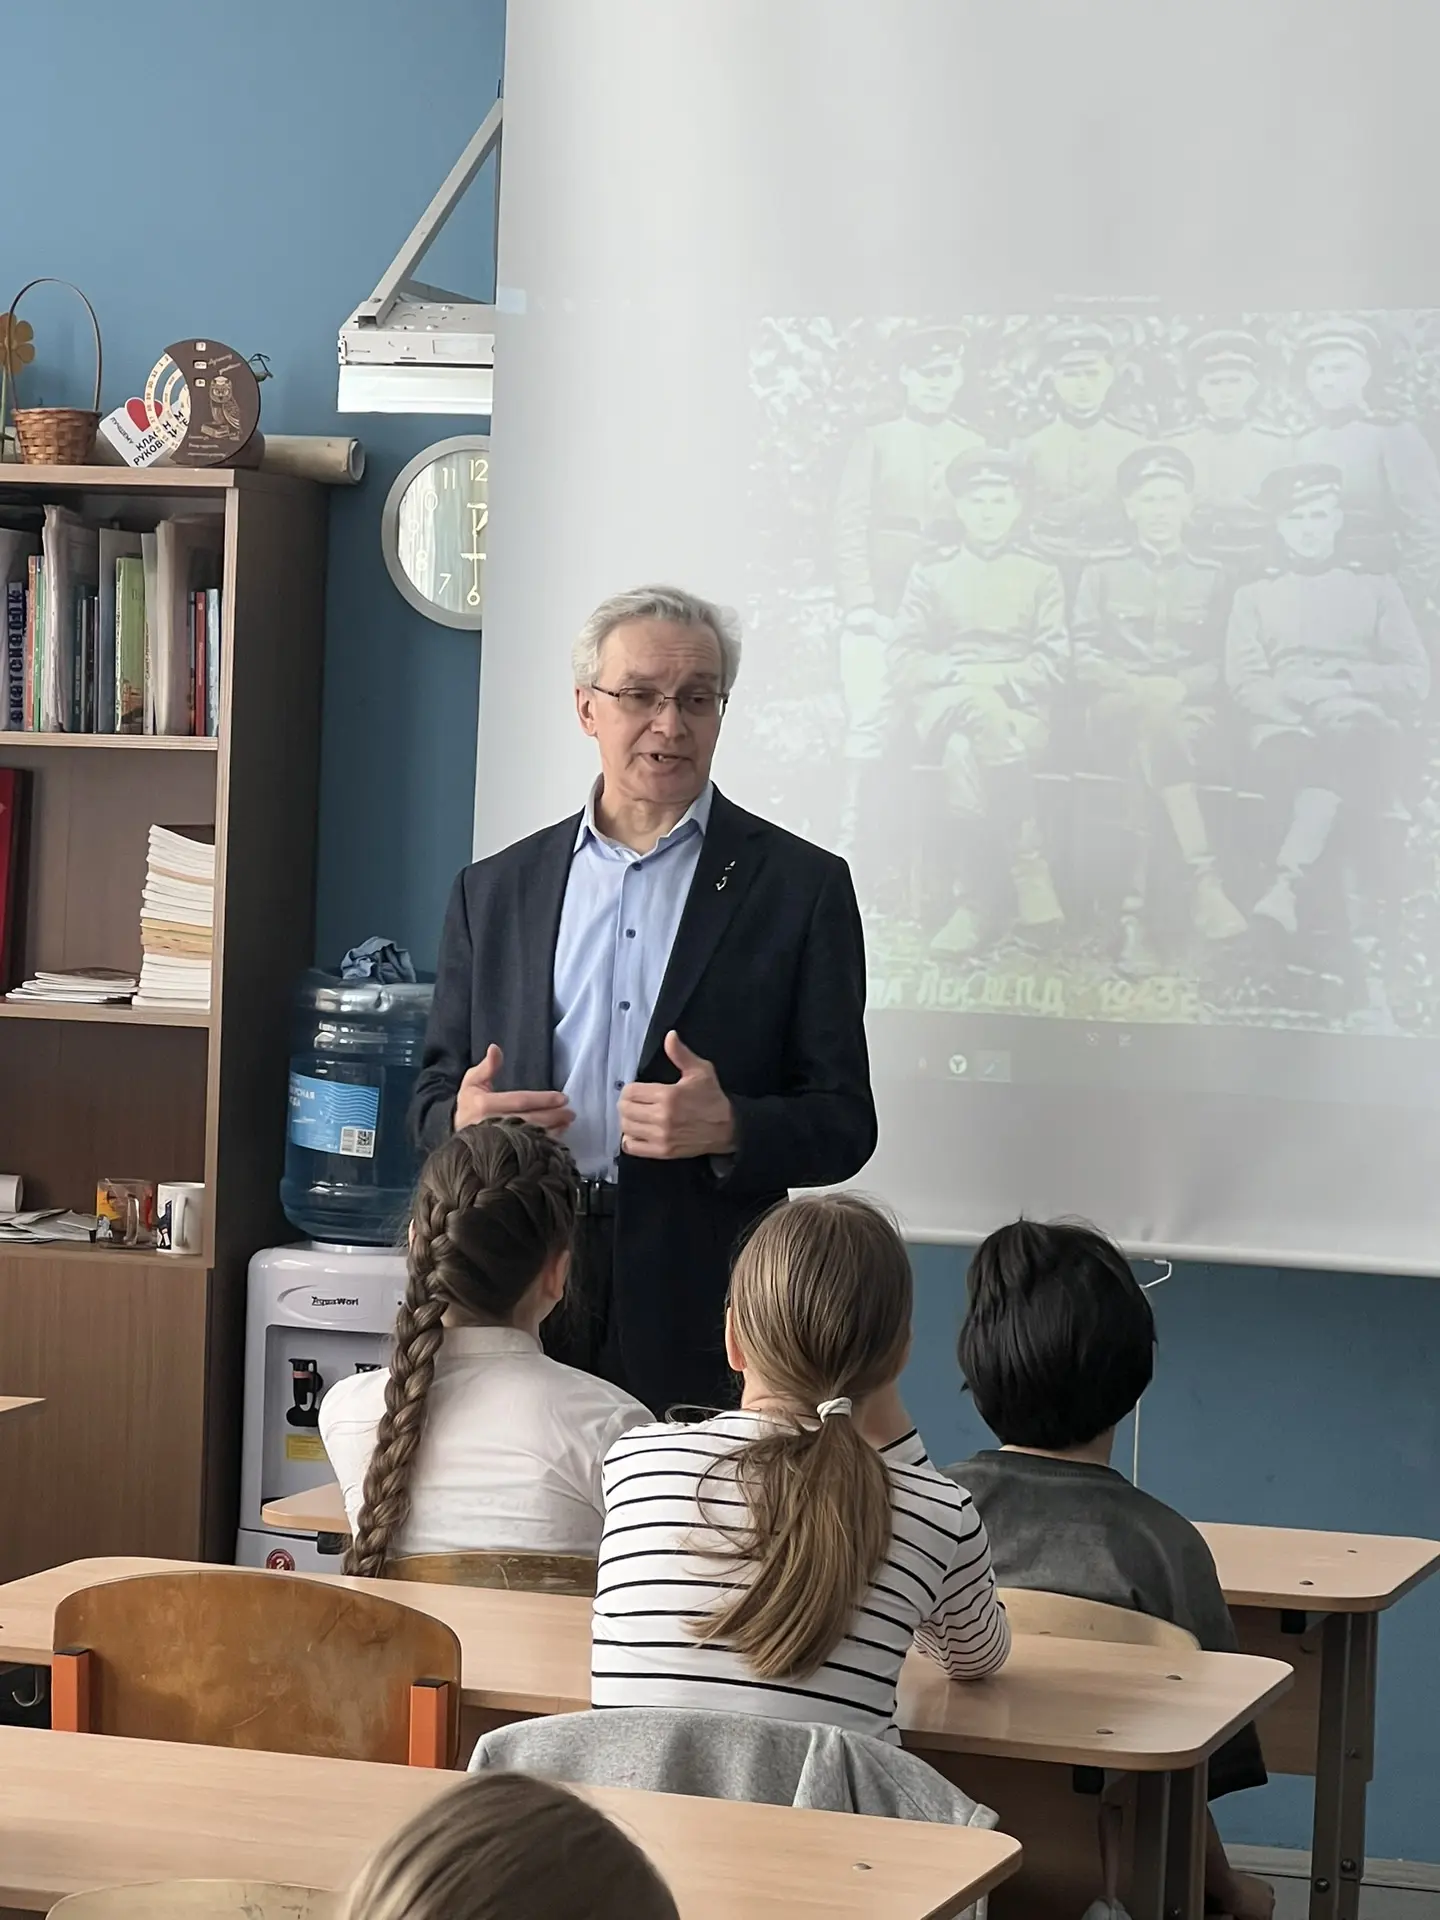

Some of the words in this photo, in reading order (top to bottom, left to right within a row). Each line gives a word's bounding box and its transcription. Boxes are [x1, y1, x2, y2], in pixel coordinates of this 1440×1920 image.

[442, 467, 456, 490] 11
[469, 459, 489, 482] 12
[416, 551, 428, 572] 8
[438, 572, 452, 595] 7
[466, 584, 481, 606] 6
